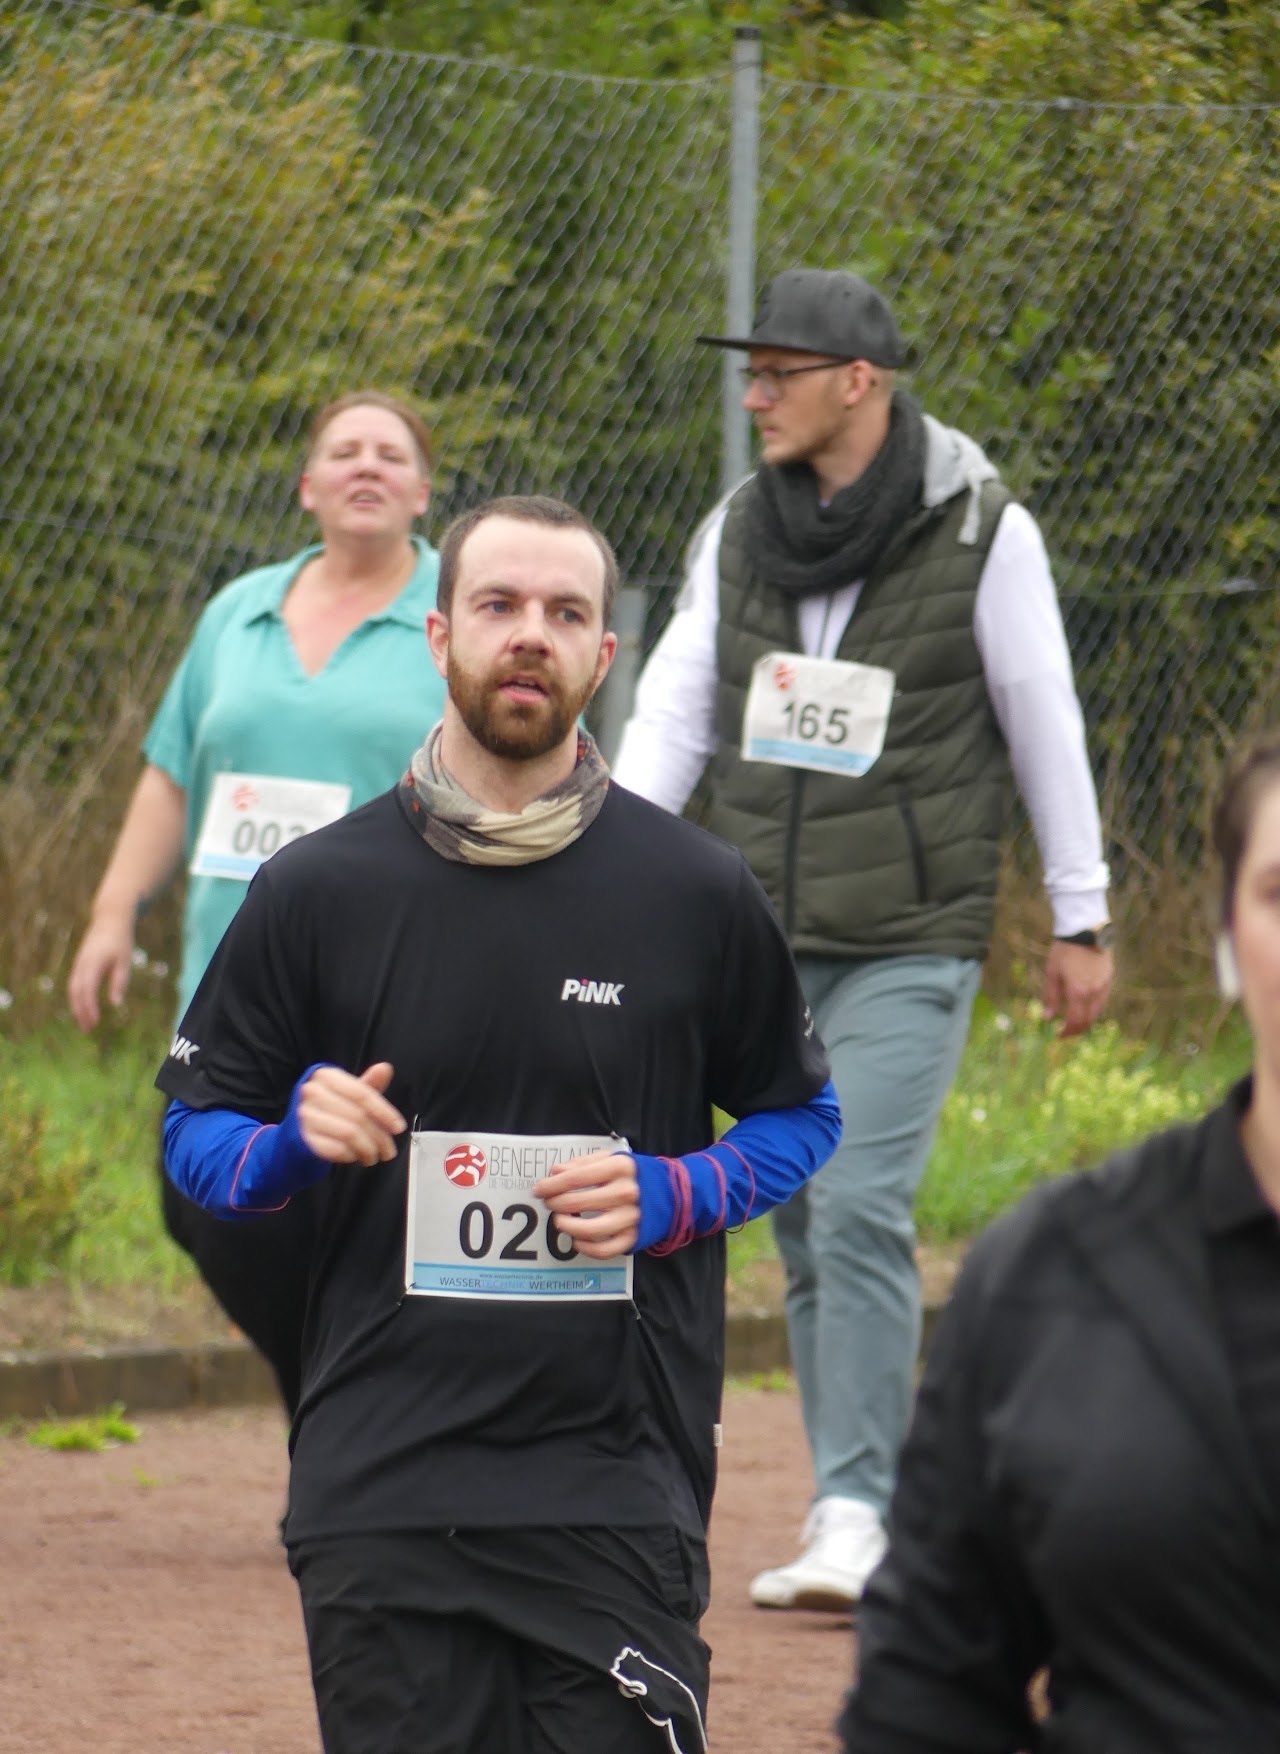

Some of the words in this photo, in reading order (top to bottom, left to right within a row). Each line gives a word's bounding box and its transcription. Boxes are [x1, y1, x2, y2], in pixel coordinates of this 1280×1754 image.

[783, 701, 850, 745] 165
[561, 978, 626, 1006] PiNK
[170, 1033, 201, 1066] NK
[529, 1280, 584, 1291] WERTHEIM
